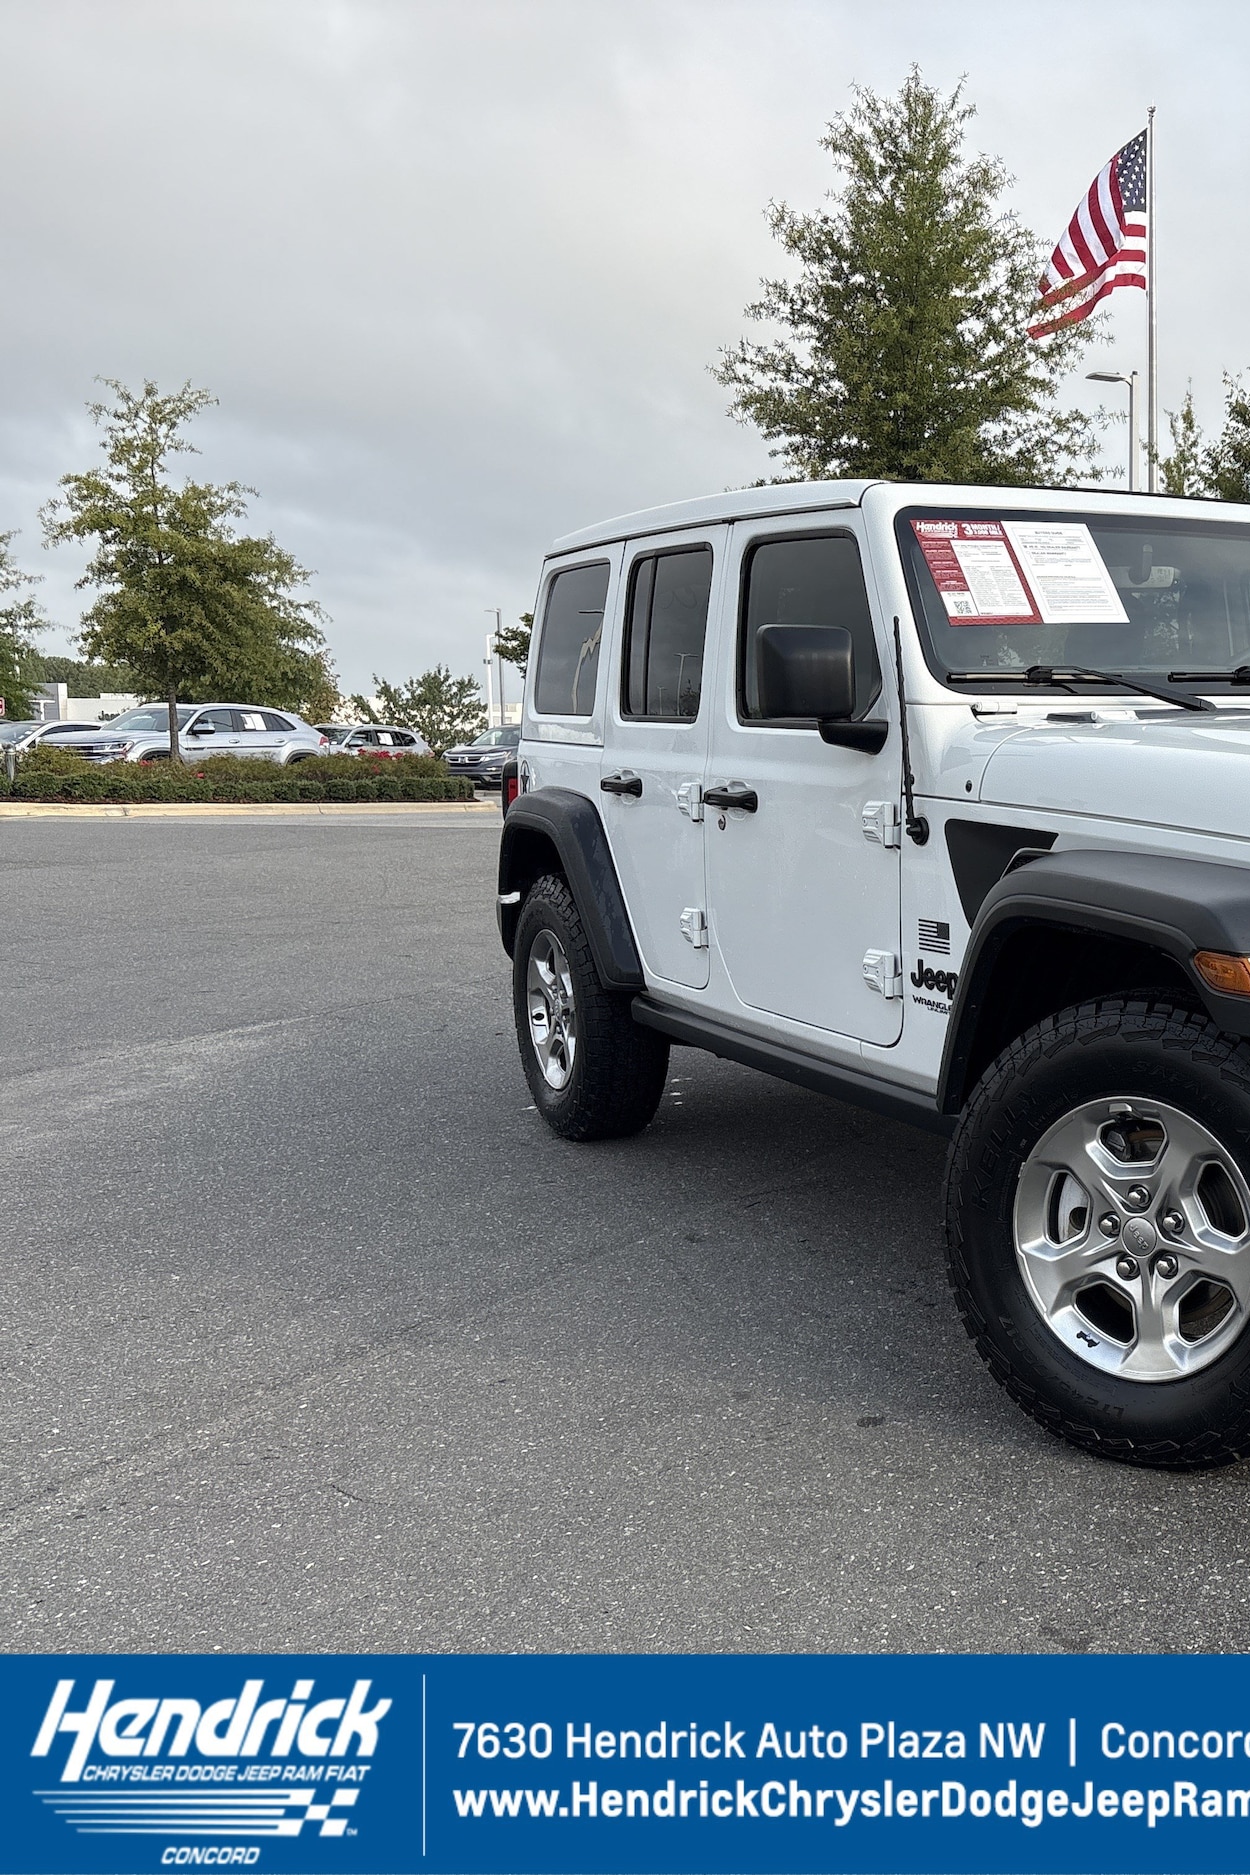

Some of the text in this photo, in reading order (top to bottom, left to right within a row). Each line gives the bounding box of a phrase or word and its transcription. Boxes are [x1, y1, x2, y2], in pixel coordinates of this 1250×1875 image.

[916, 521, 958, 532] Hendrick
[910, 958, 959, 1000] Jeep
[1129, 1224, 1149, 1250] Jeep
